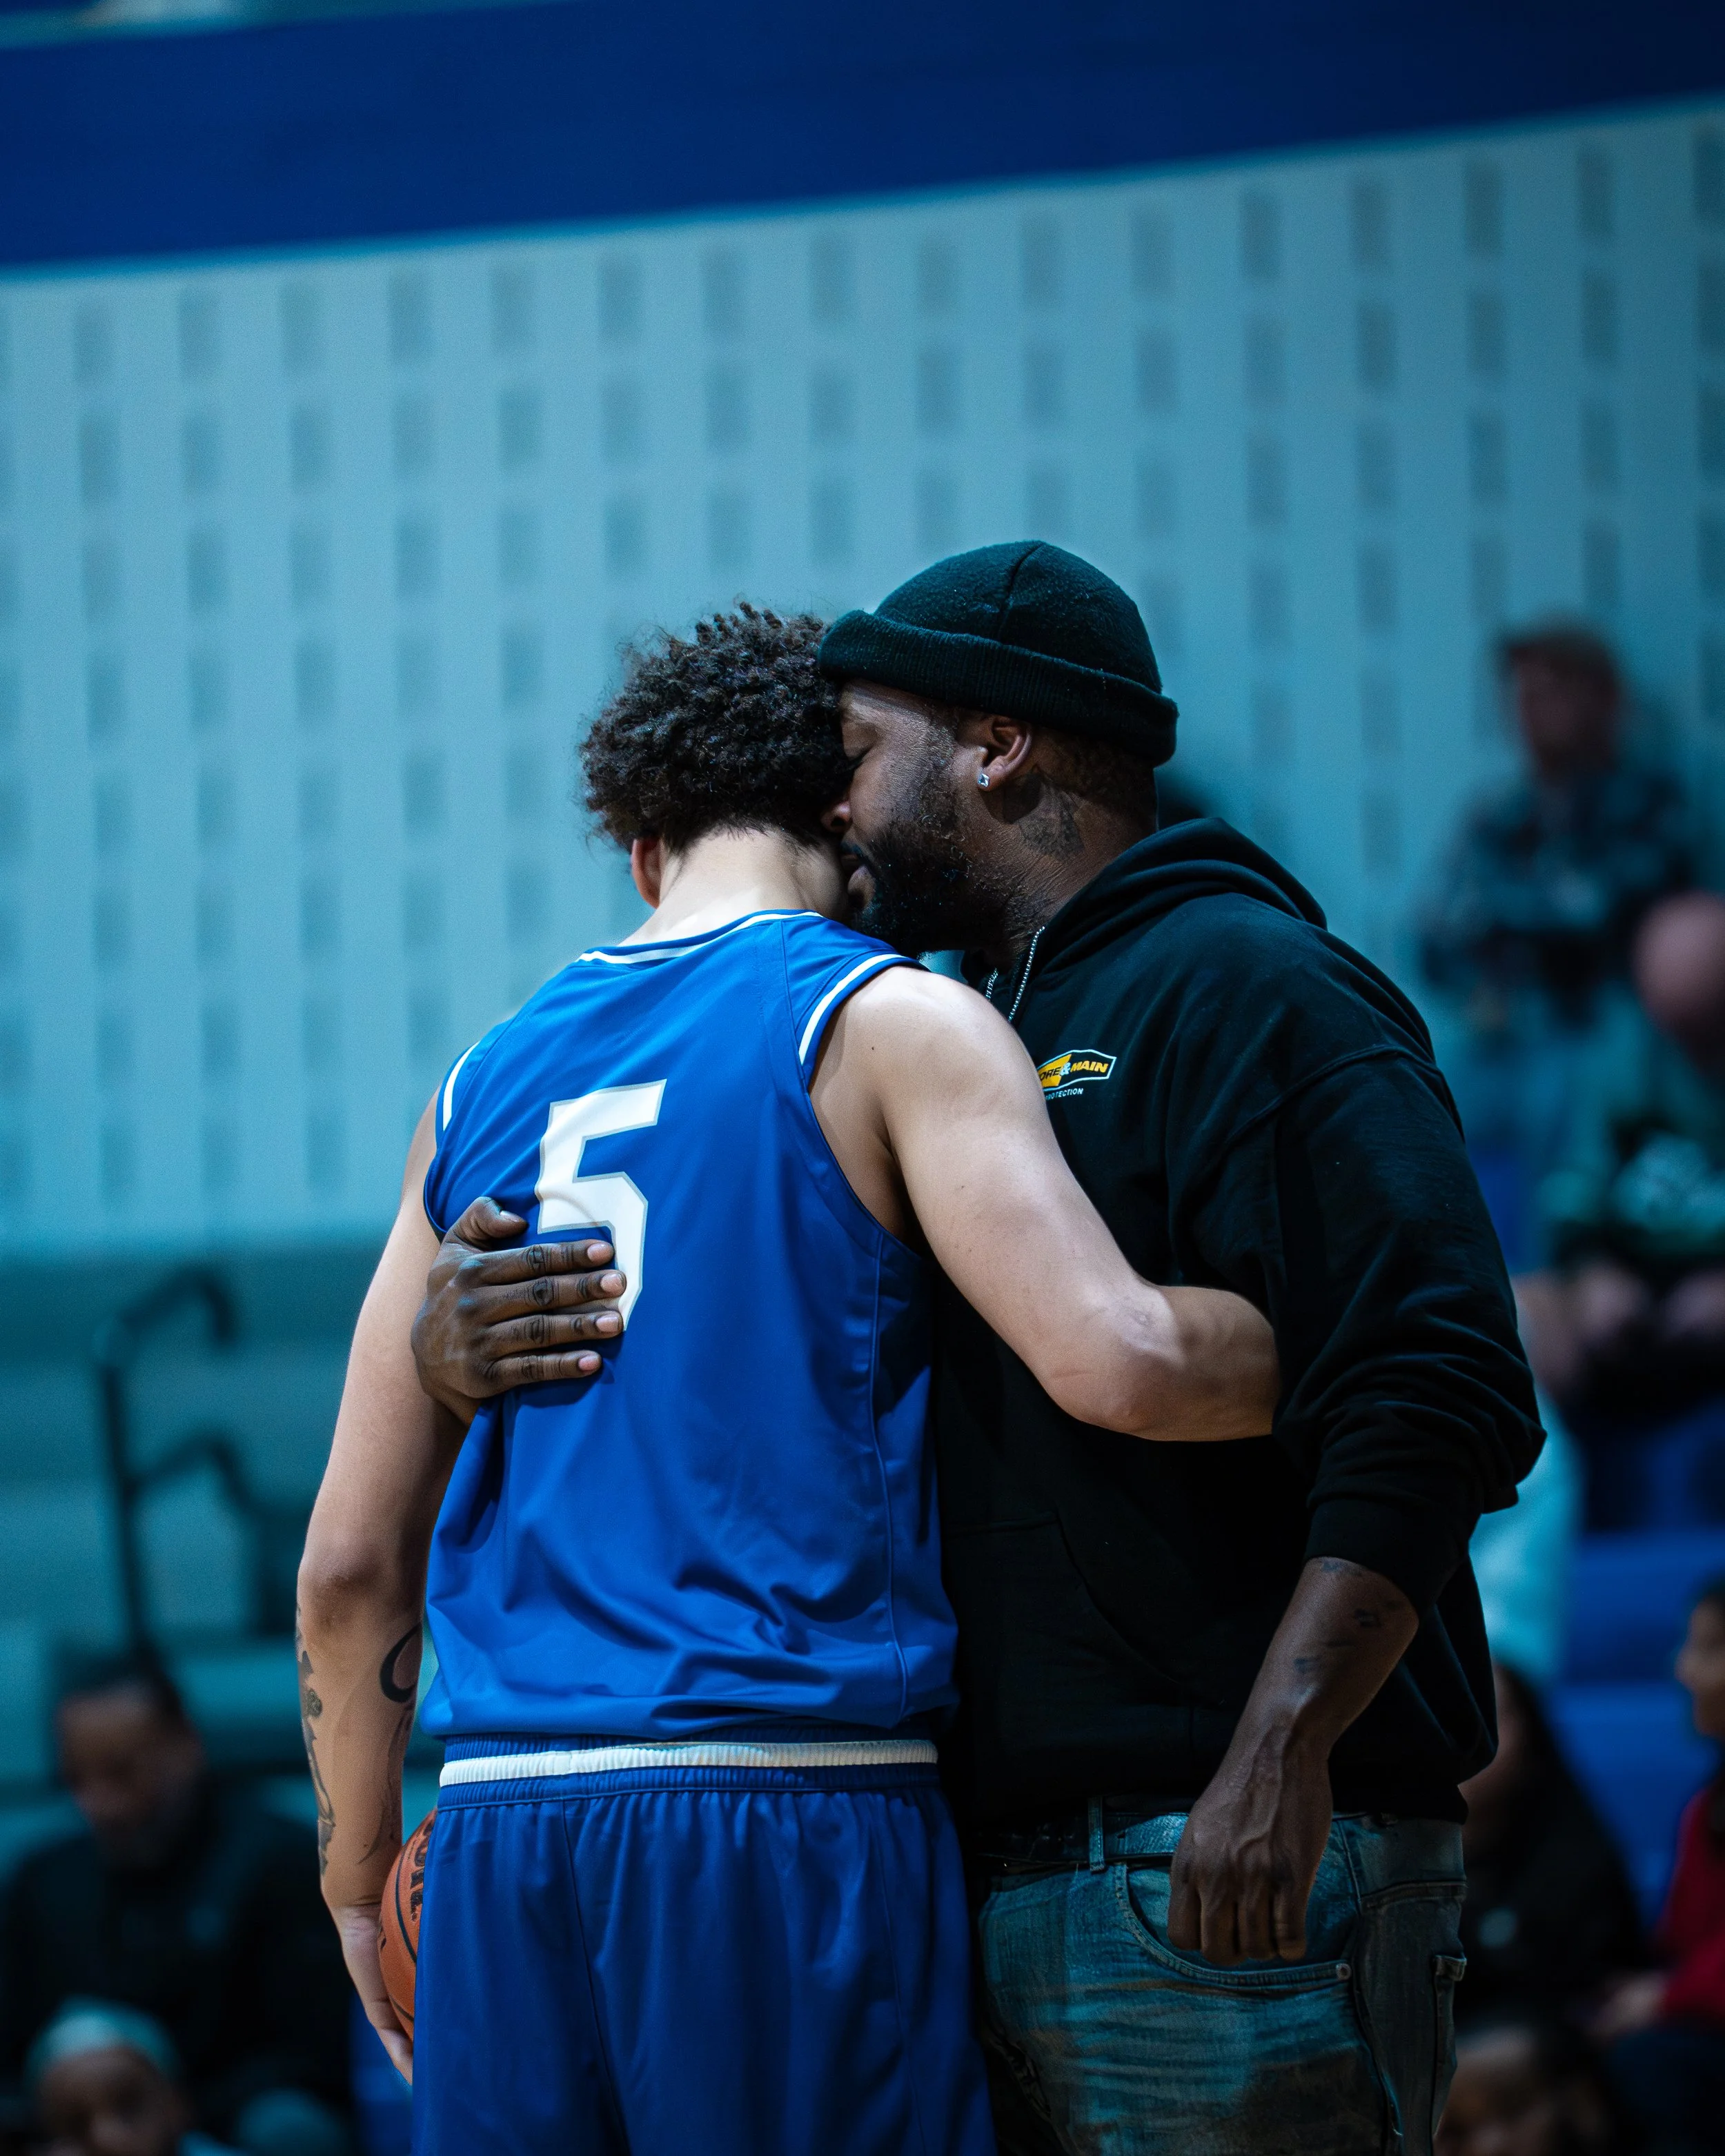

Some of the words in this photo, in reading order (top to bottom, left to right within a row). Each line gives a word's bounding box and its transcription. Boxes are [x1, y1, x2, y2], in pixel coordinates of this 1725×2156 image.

[1039, 1067, 1061, 1081] ORE
[1059, 1062, 1072, 1076] &
[1070, 1060, 1109, 1073] MAIN
[534, 1078, 667, 1332] 5
